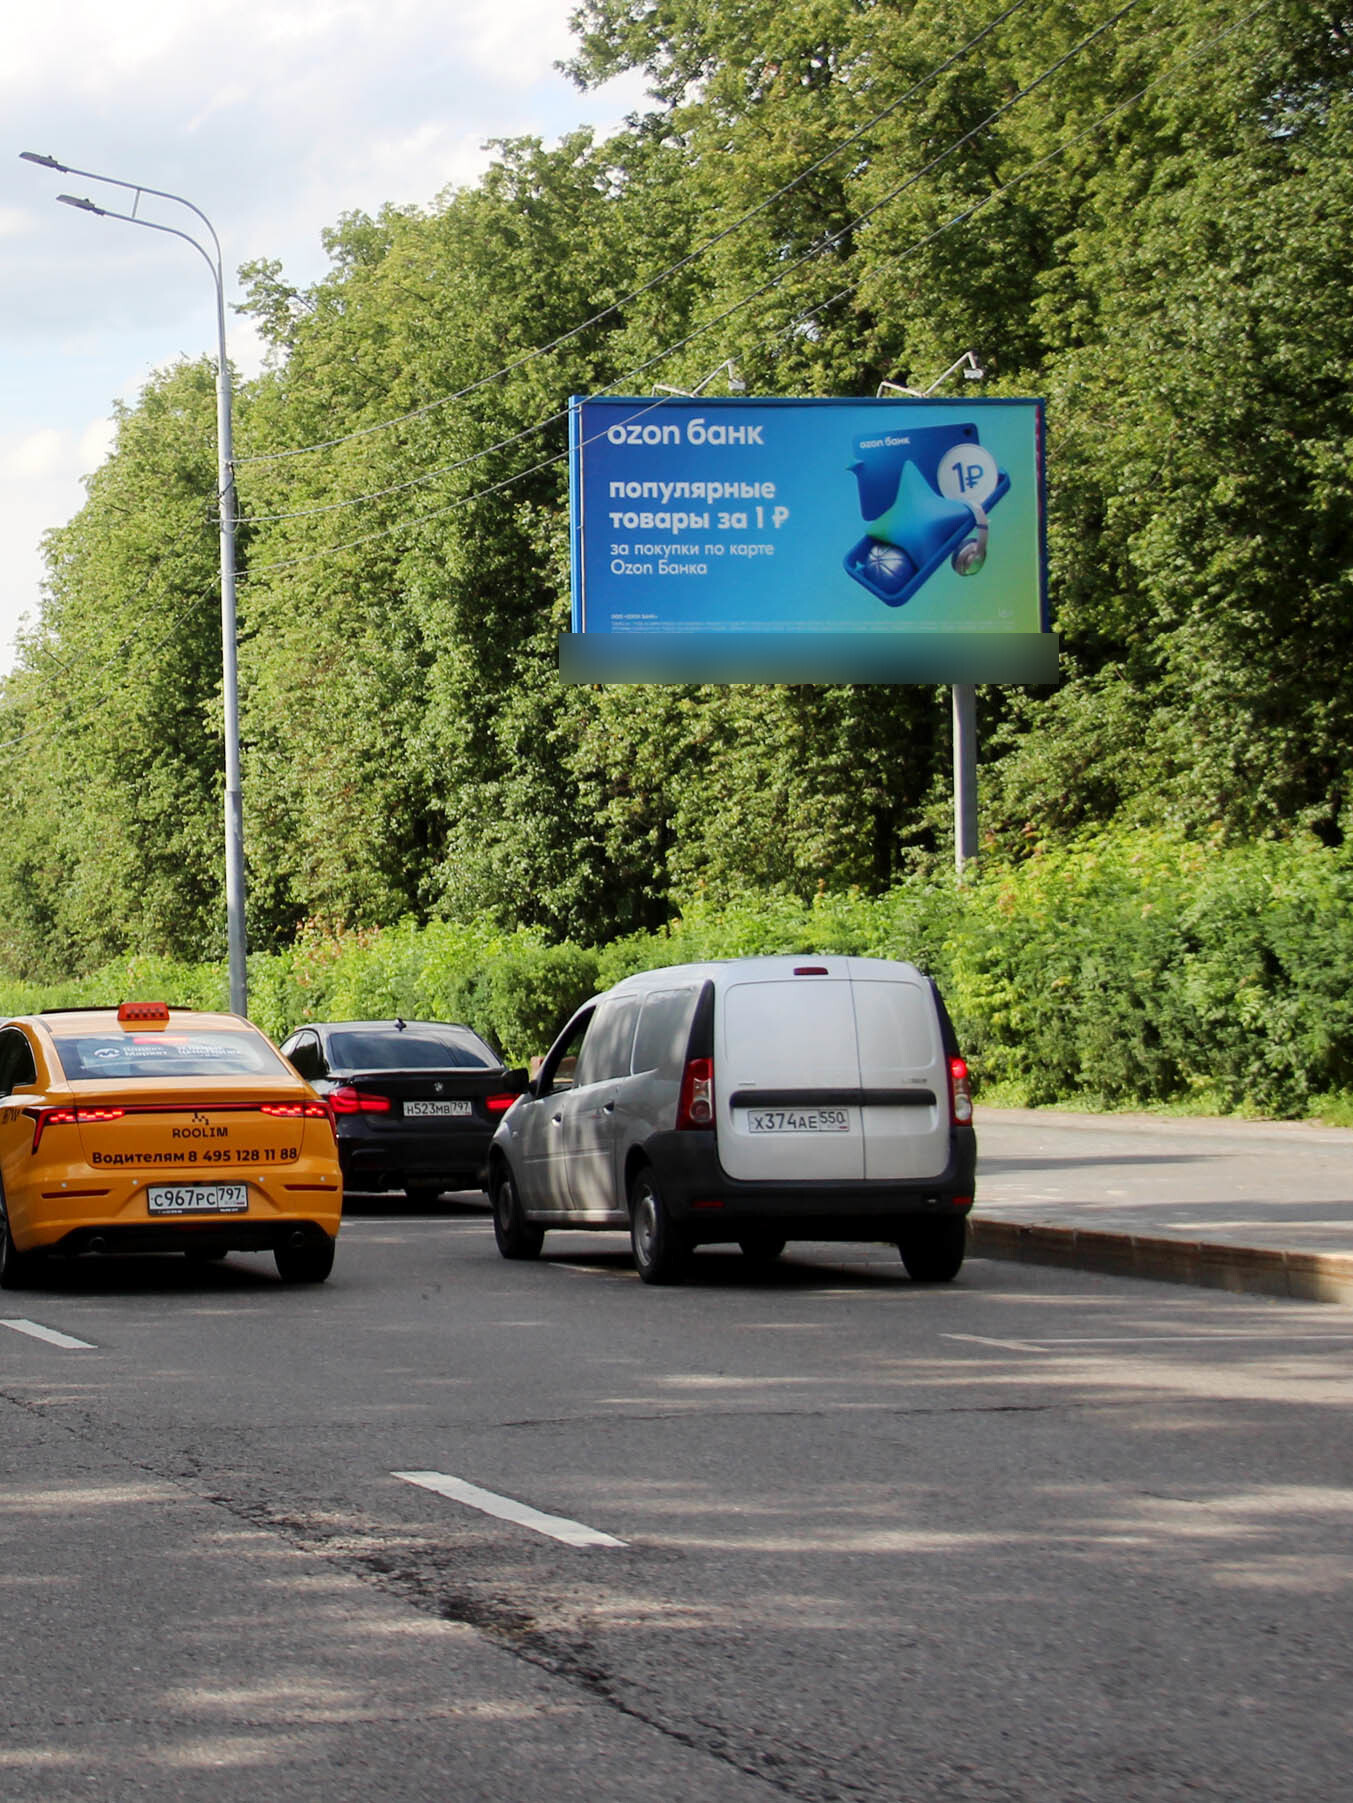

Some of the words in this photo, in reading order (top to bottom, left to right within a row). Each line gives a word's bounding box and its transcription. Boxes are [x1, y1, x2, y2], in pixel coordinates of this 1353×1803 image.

[607, 425, 681, 445] ozon
[686, 418, 765, 445] банк
[608, 481, 777, 505] популярные
[608, 512, 710, 535] товары
[716, 512, 748, 529] за
[754, 506, 765, 529] 1
[610, 543, 629, 556] за
[634, 543, 700, 559] покупки
[704, 543, 725, 556] по
[729, 543, 776, 559] карте
[610, 558, 653, 576] Ozon
[658, 558, 708, 575] Банка
[171, 1127, 229, 1139] ROOLIM
[92, 1151, 185, 1165] Водителям
[188, 1151, 198, 1163] 8
[202, 1150, 231, 1162] 495
[236, 1149, 260, 1161] 128
[264, 1149, 276, 1160] 11
[280, 1147, 298, 1160] 88
[218, 1187, 242, 1201] 797
